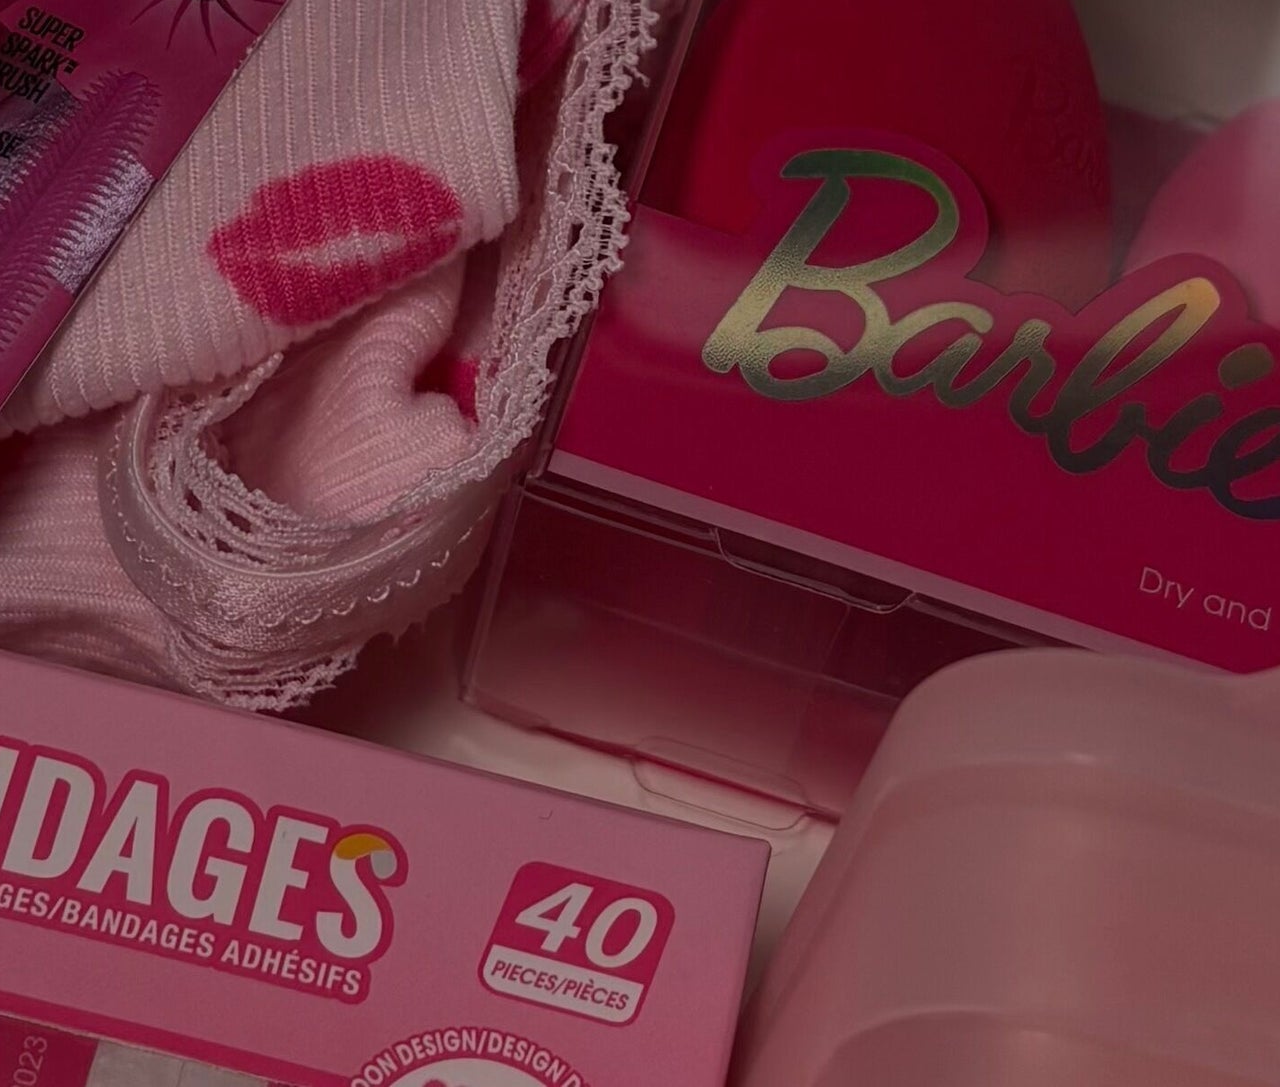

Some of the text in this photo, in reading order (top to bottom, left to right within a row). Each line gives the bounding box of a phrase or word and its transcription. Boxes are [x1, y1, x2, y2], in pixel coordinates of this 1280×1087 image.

[19, 6, 85, 52] SUPER
[1139, 566, 1194, 609] Dry
[1203, 590, 1273, 632] and
[515, 881, 658, 969] 40
[220, 938, 363, 997] ADHÉSIFS
[490, 959, 630, 1011] PIECES/PIÈCES
[10, 1034, 48, 1087] 023
